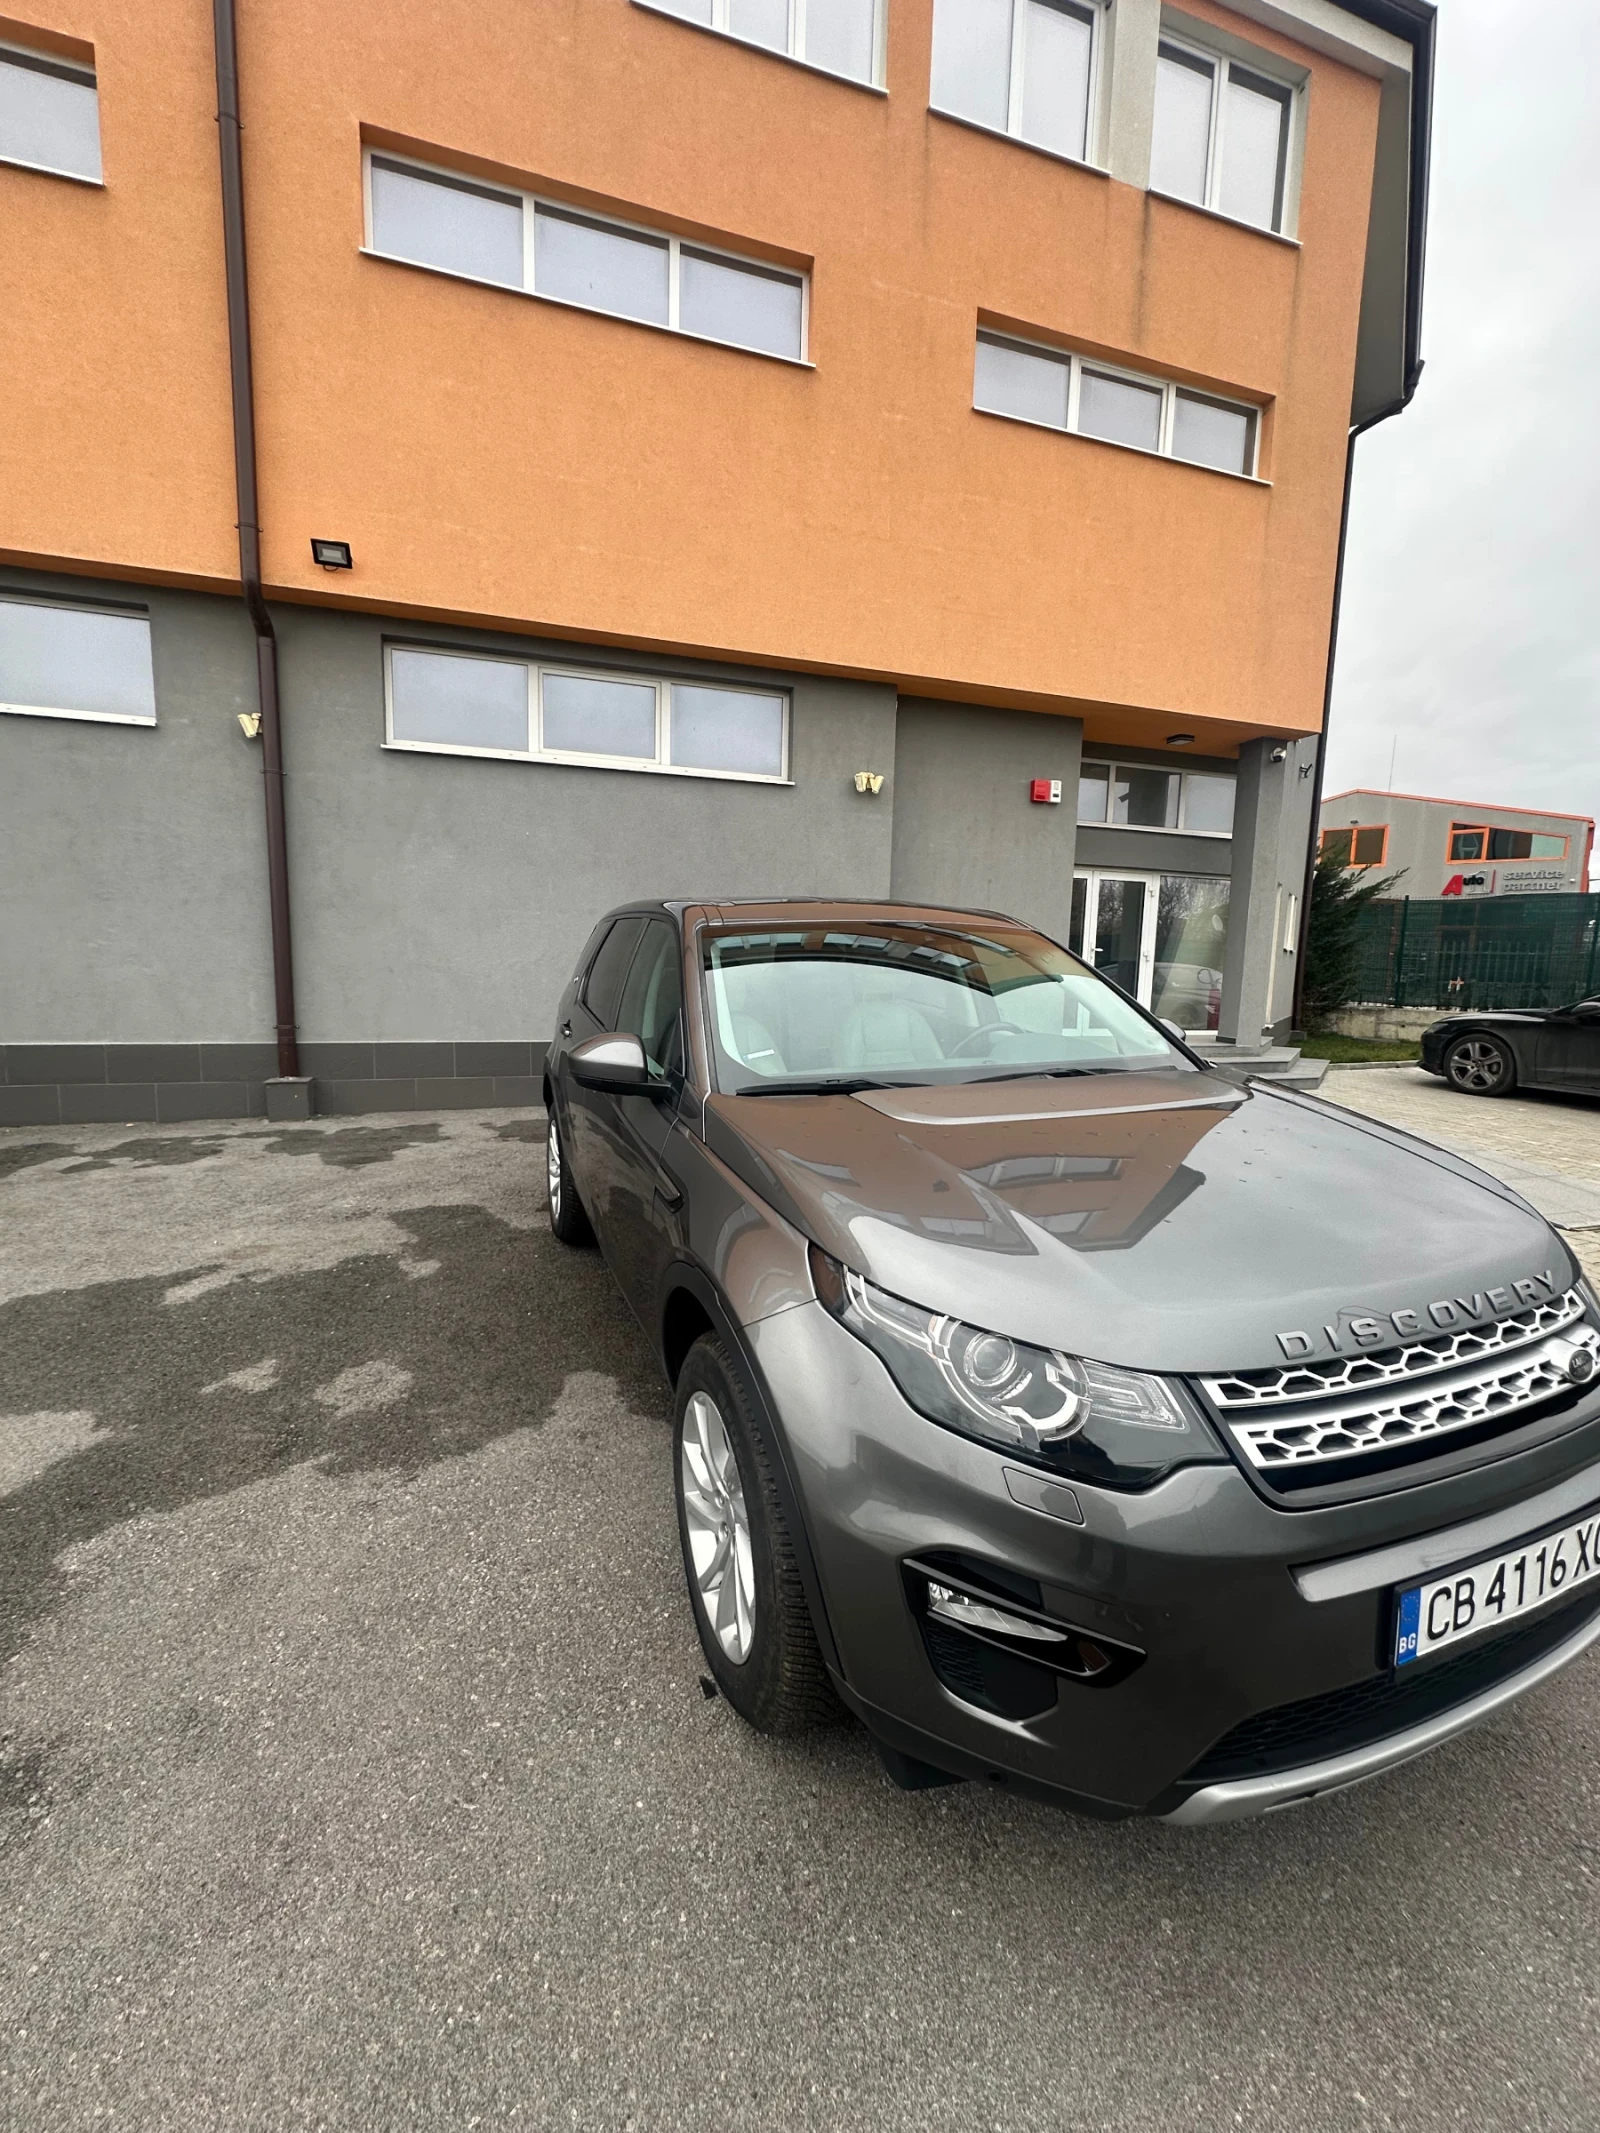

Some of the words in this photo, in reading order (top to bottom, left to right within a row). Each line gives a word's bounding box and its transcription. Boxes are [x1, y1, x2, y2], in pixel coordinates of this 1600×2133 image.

[1503, 869, 1564, 880] service
[1504, 881, 1562, 892] partner
[1275, 1269, 1557, 1361] DISCOVERY
[1426, 1576, 1476, 1641] CB
[1484, 1536, 1567, 1614] 4116
[1398, 1632, 1417, 1654] BG
